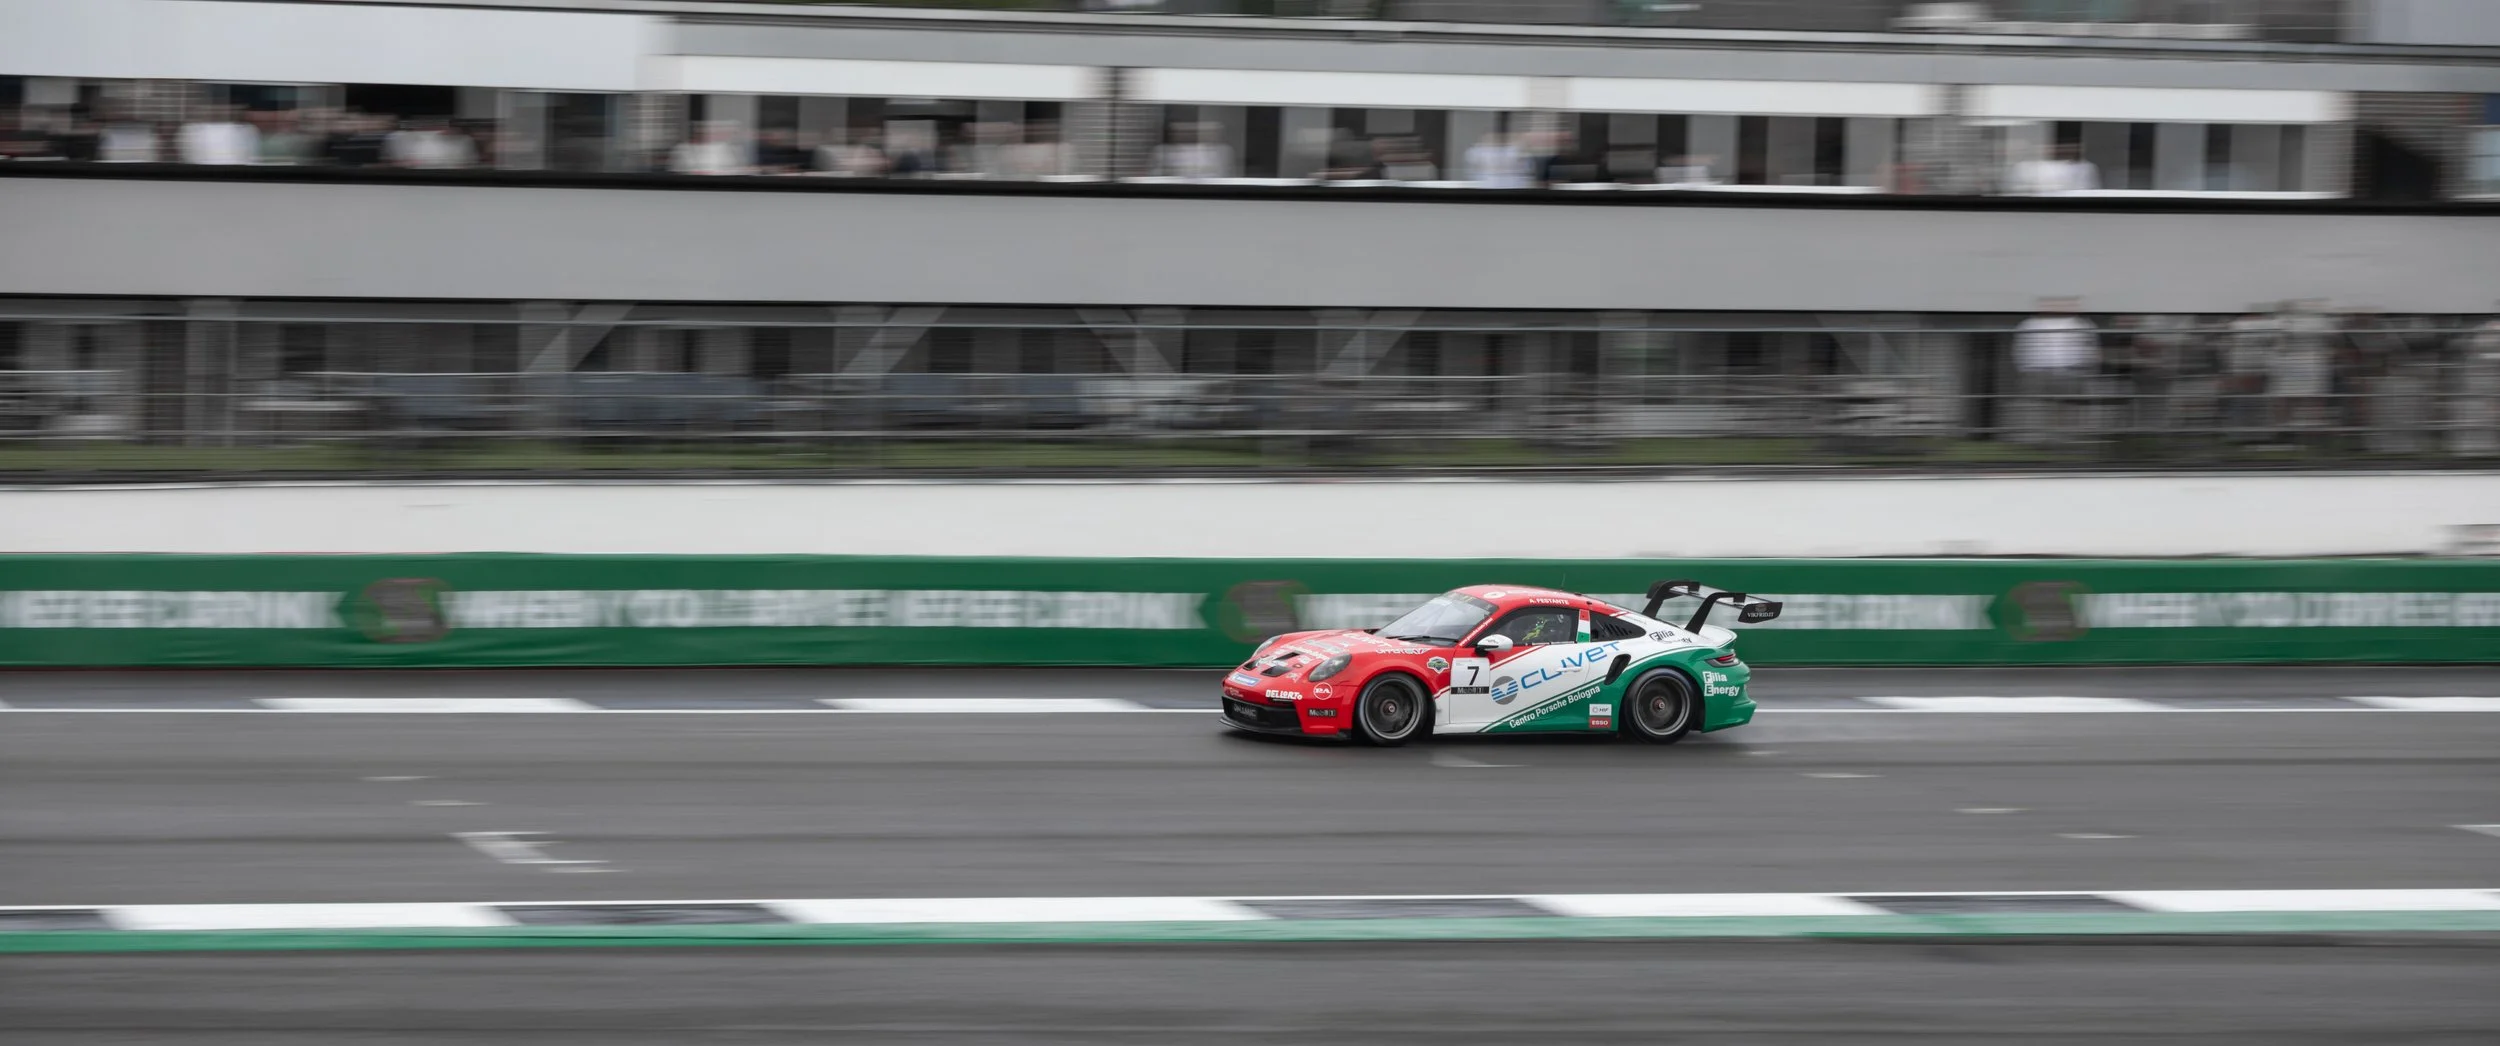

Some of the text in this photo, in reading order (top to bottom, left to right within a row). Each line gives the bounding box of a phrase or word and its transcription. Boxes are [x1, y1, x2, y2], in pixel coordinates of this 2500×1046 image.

[1467, 666, 1480, 686] 7
[1567, 685, 1600, 704] Bologna
[1704, 684, 1740, 697] Energy
[1509, 713, 1536, 729] Centro
[1535, 699, 1568, 718] Porsche
